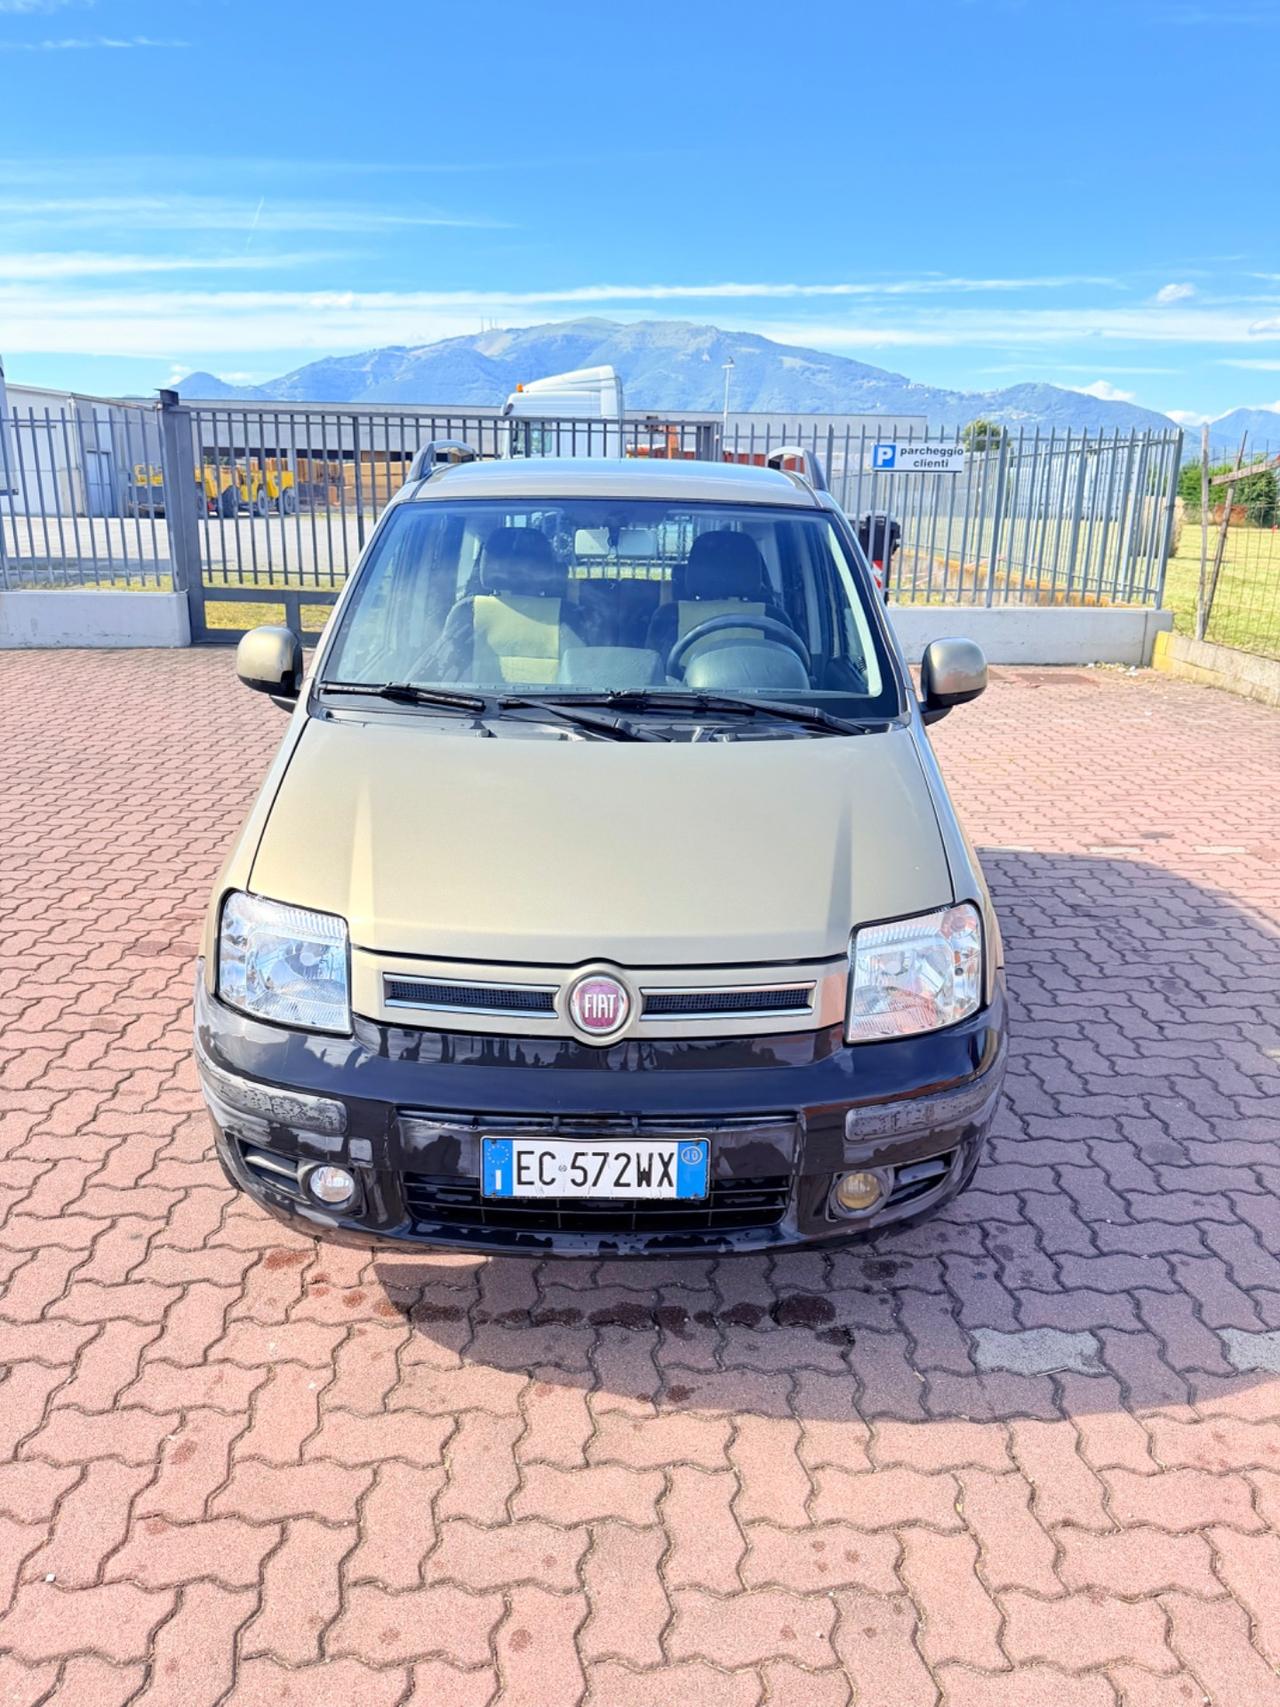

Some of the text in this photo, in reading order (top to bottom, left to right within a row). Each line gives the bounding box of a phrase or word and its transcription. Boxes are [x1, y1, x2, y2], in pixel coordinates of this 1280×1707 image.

[900, 447, 964, 457] parcheggio
[913, 459, 949, 468] clienti
[584, 994, 617, 1018] FIAT
[516, 1150, 675, 1188] EC 572WX
